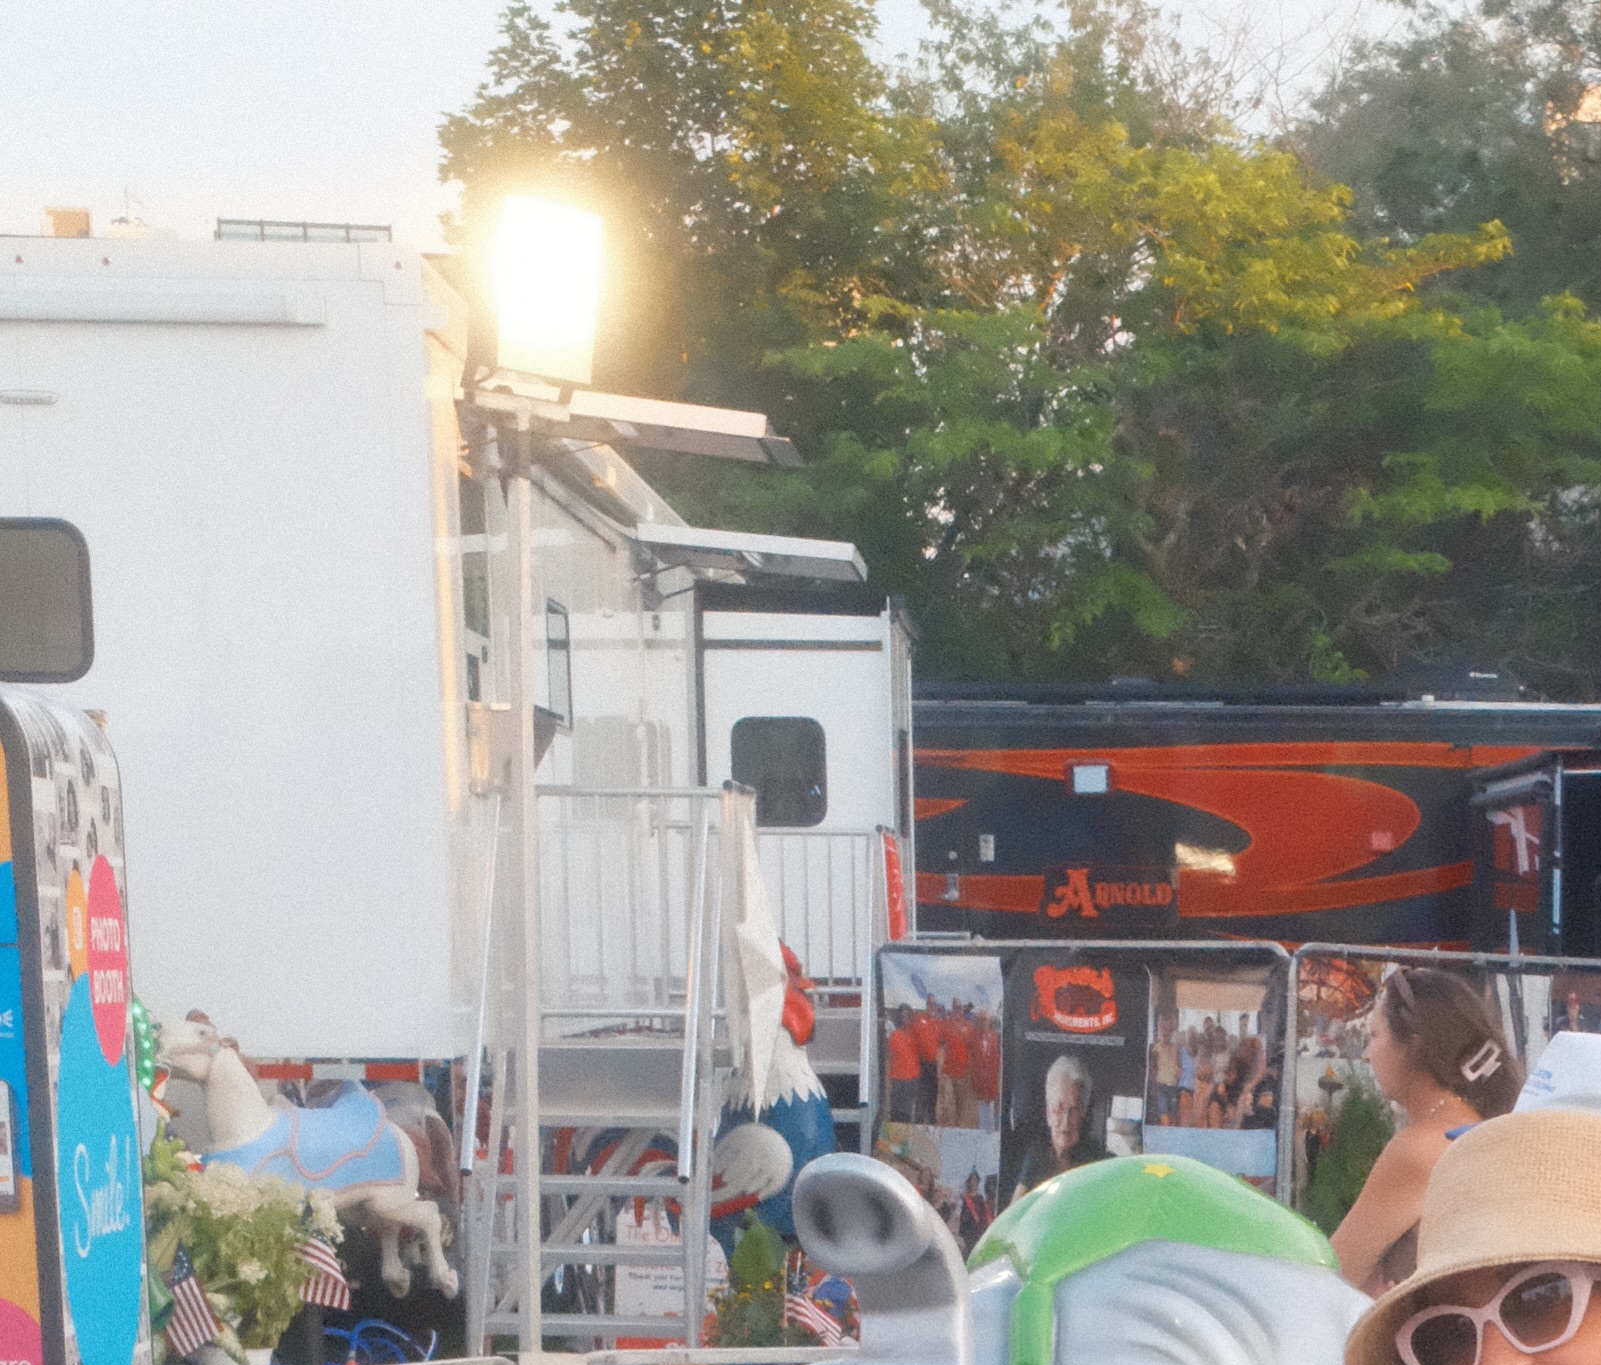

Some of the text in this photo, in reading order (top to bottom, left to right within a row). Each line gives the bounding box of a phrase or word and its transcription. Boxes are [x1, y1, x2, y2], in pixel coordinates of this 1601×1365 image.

[91, 916, 120, 953] PHOTO
[93, 970, 124, 1004] BOOTH
[73, 1133, 131, 1258] Smile!
